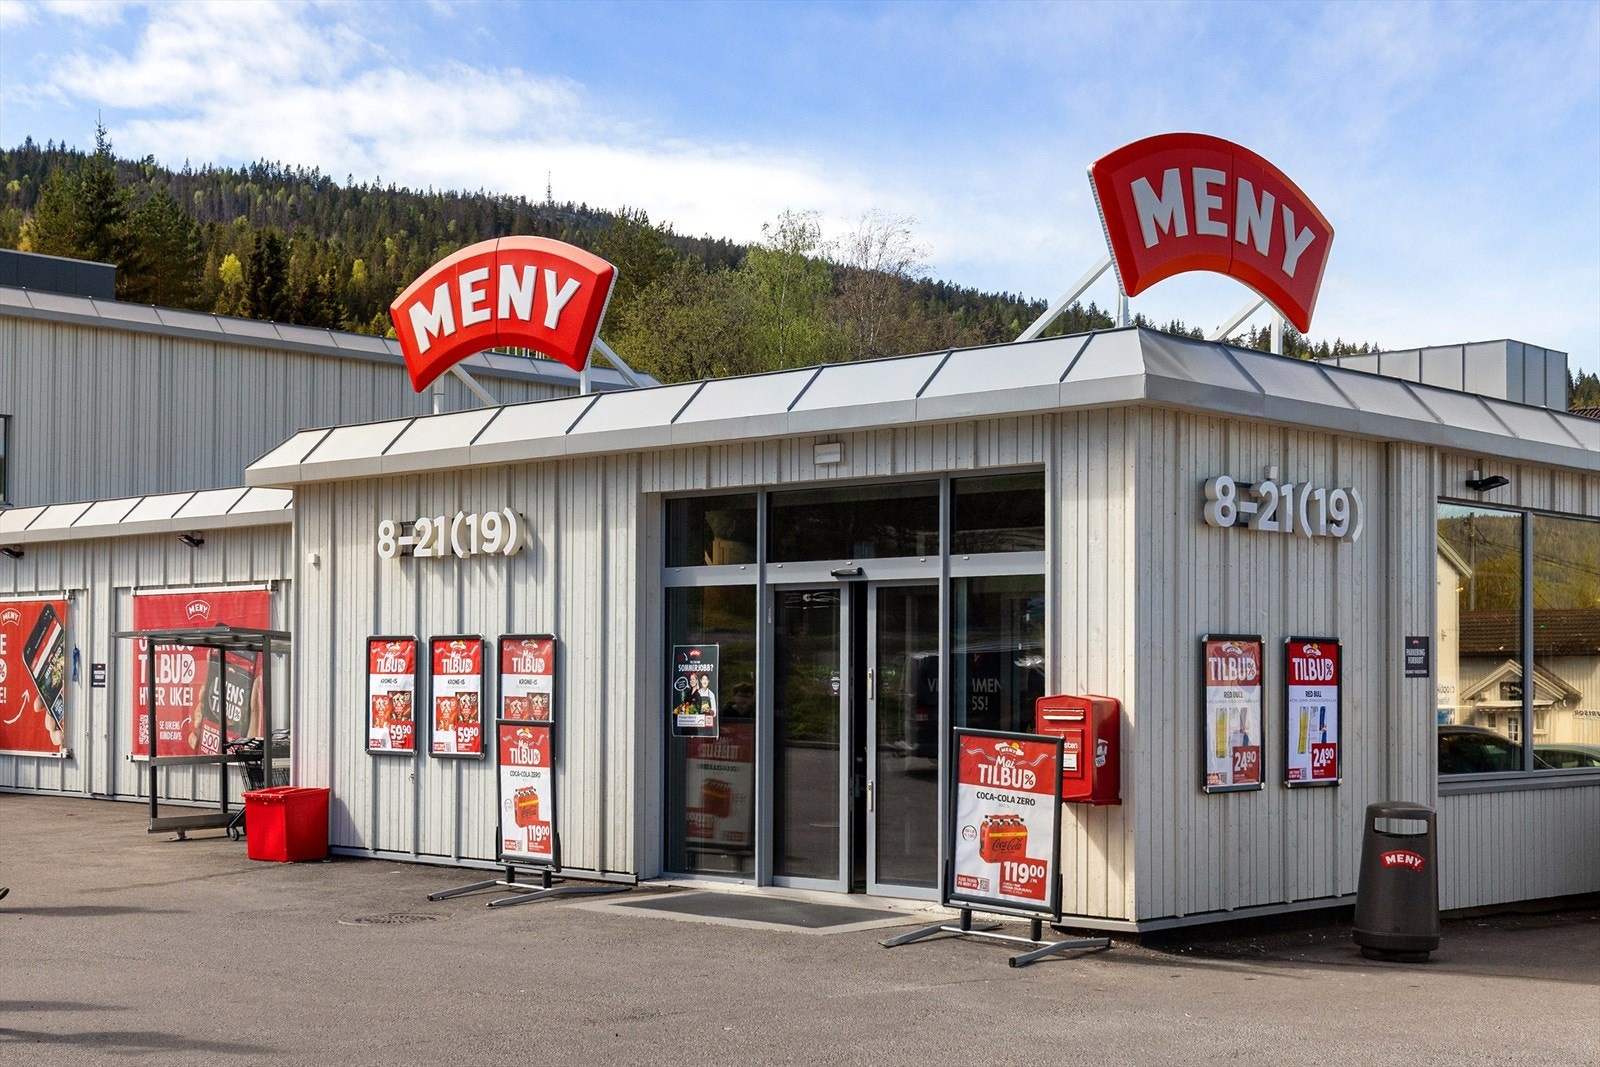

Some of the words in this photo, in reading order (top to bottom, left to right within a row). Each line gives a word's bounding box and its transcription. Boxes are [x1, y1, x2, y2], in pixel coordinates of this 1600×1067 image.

[1130, 167, 1316, 278] MENY
[408, 264, 582, 355] MENY
[2, 610, 19, 622] MENY
[188, 603, 208, 615] MENY
[138, 653, 196, 684] TLBUD
[170, 686, 193, 707] UKE!
[202, 730, 220, 751] 500
[995, 755, 1016, 769] Mai
[976, 791, 1015, 804] COCA-COLA
[1016, 796, 1036, 807] ZERO
[1385, 853, 1422, 867] MENY
